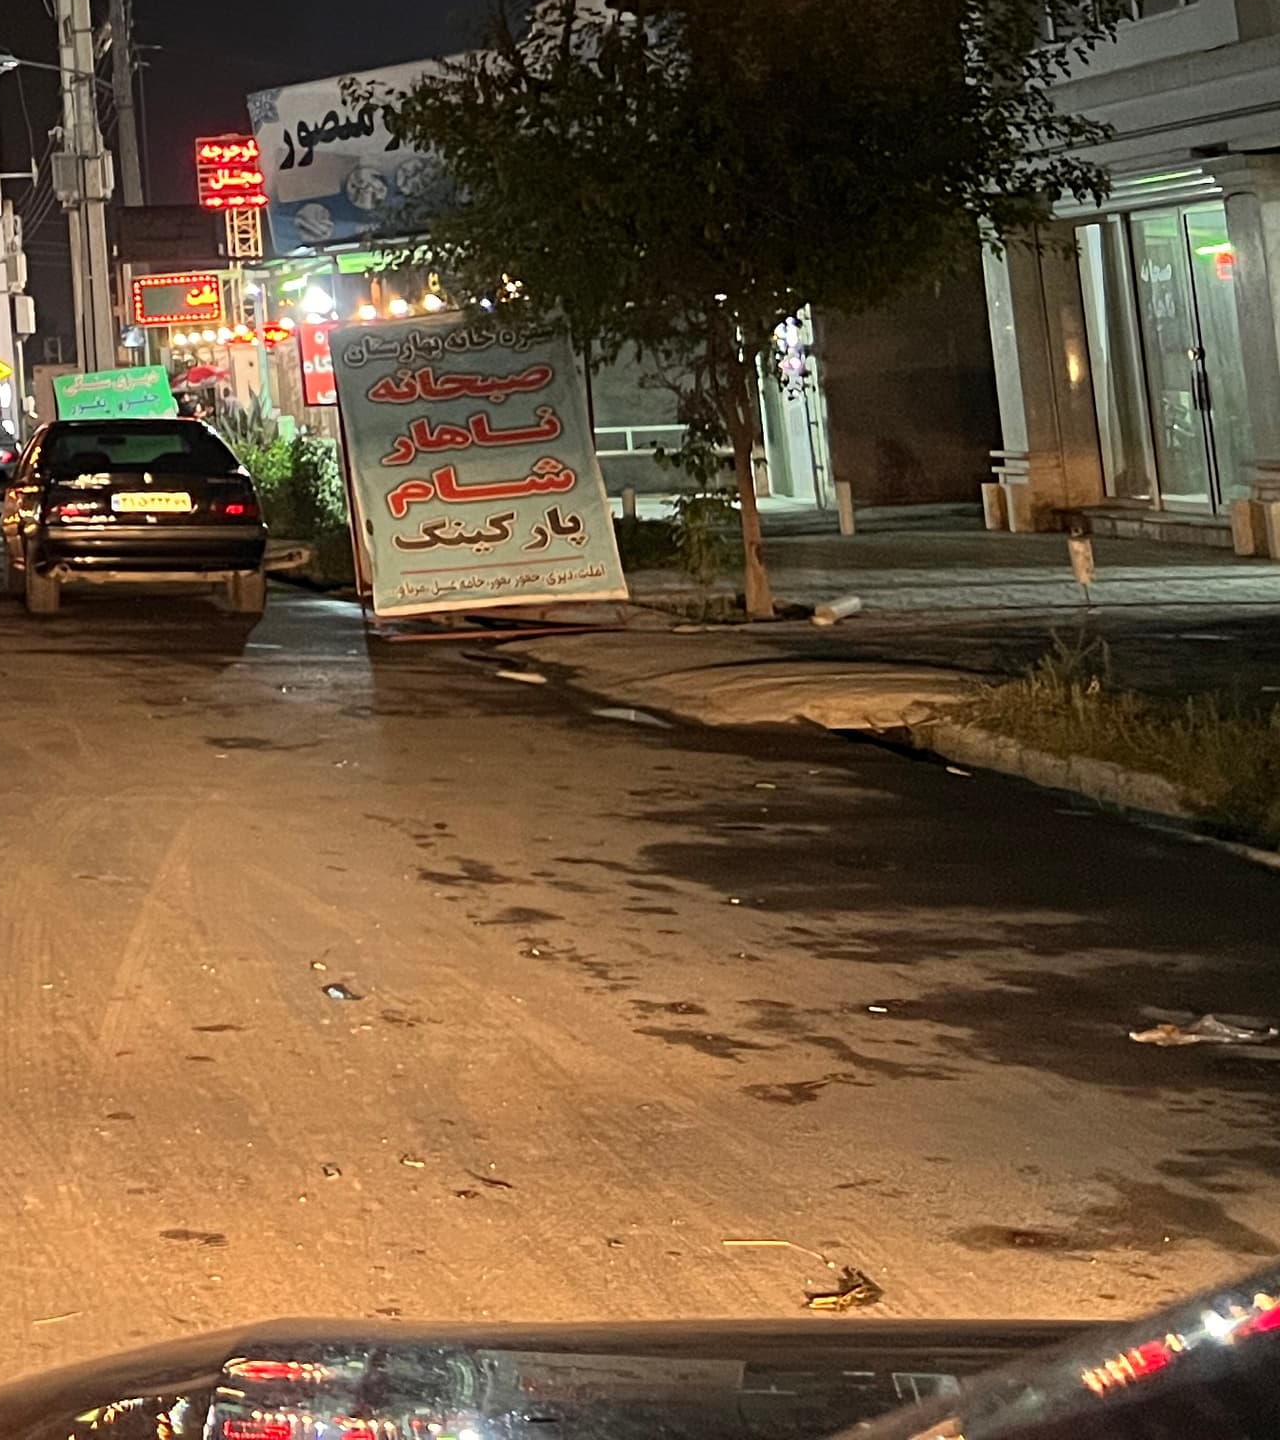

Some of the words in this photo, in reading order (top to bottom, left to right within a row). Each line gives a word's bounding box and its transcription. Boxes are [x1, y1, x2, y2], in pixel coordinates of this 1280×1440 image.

[279, 103, 377, 170] منصور
[343, 331, 443, 367] بهارستان
[444, 327, 496, 352] خانه
[368, 364, 553, 405] صبحانه
[382, 406, 562, 466] ناهار
[386, 457, 577, 518] شام
